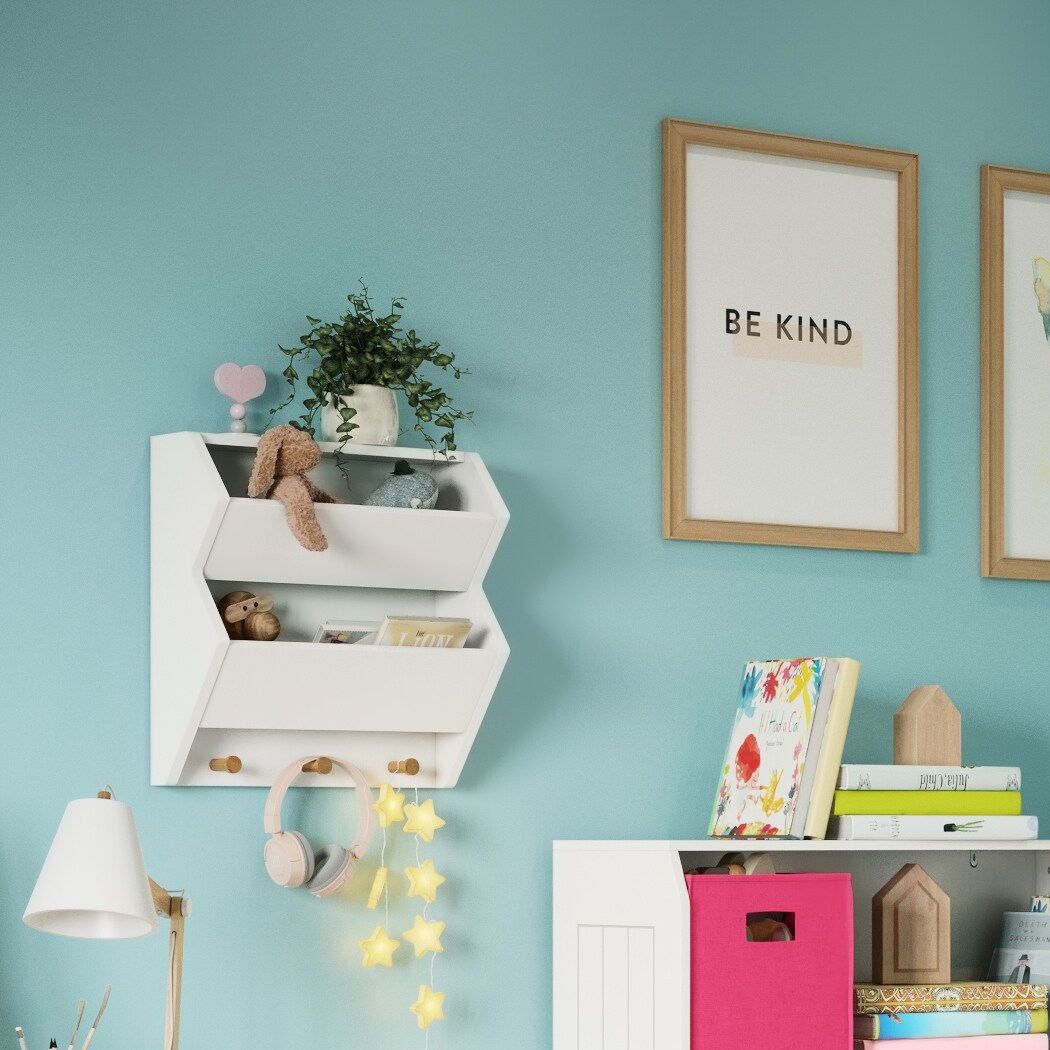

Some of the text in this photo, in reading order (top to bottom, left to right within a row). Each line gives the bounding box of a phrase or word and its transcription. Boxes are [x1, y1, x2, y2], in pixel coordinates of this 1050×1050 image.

[725, 308, 853, 346] BE KIND
[1008, 934, 1050, 943] SALESMAN
